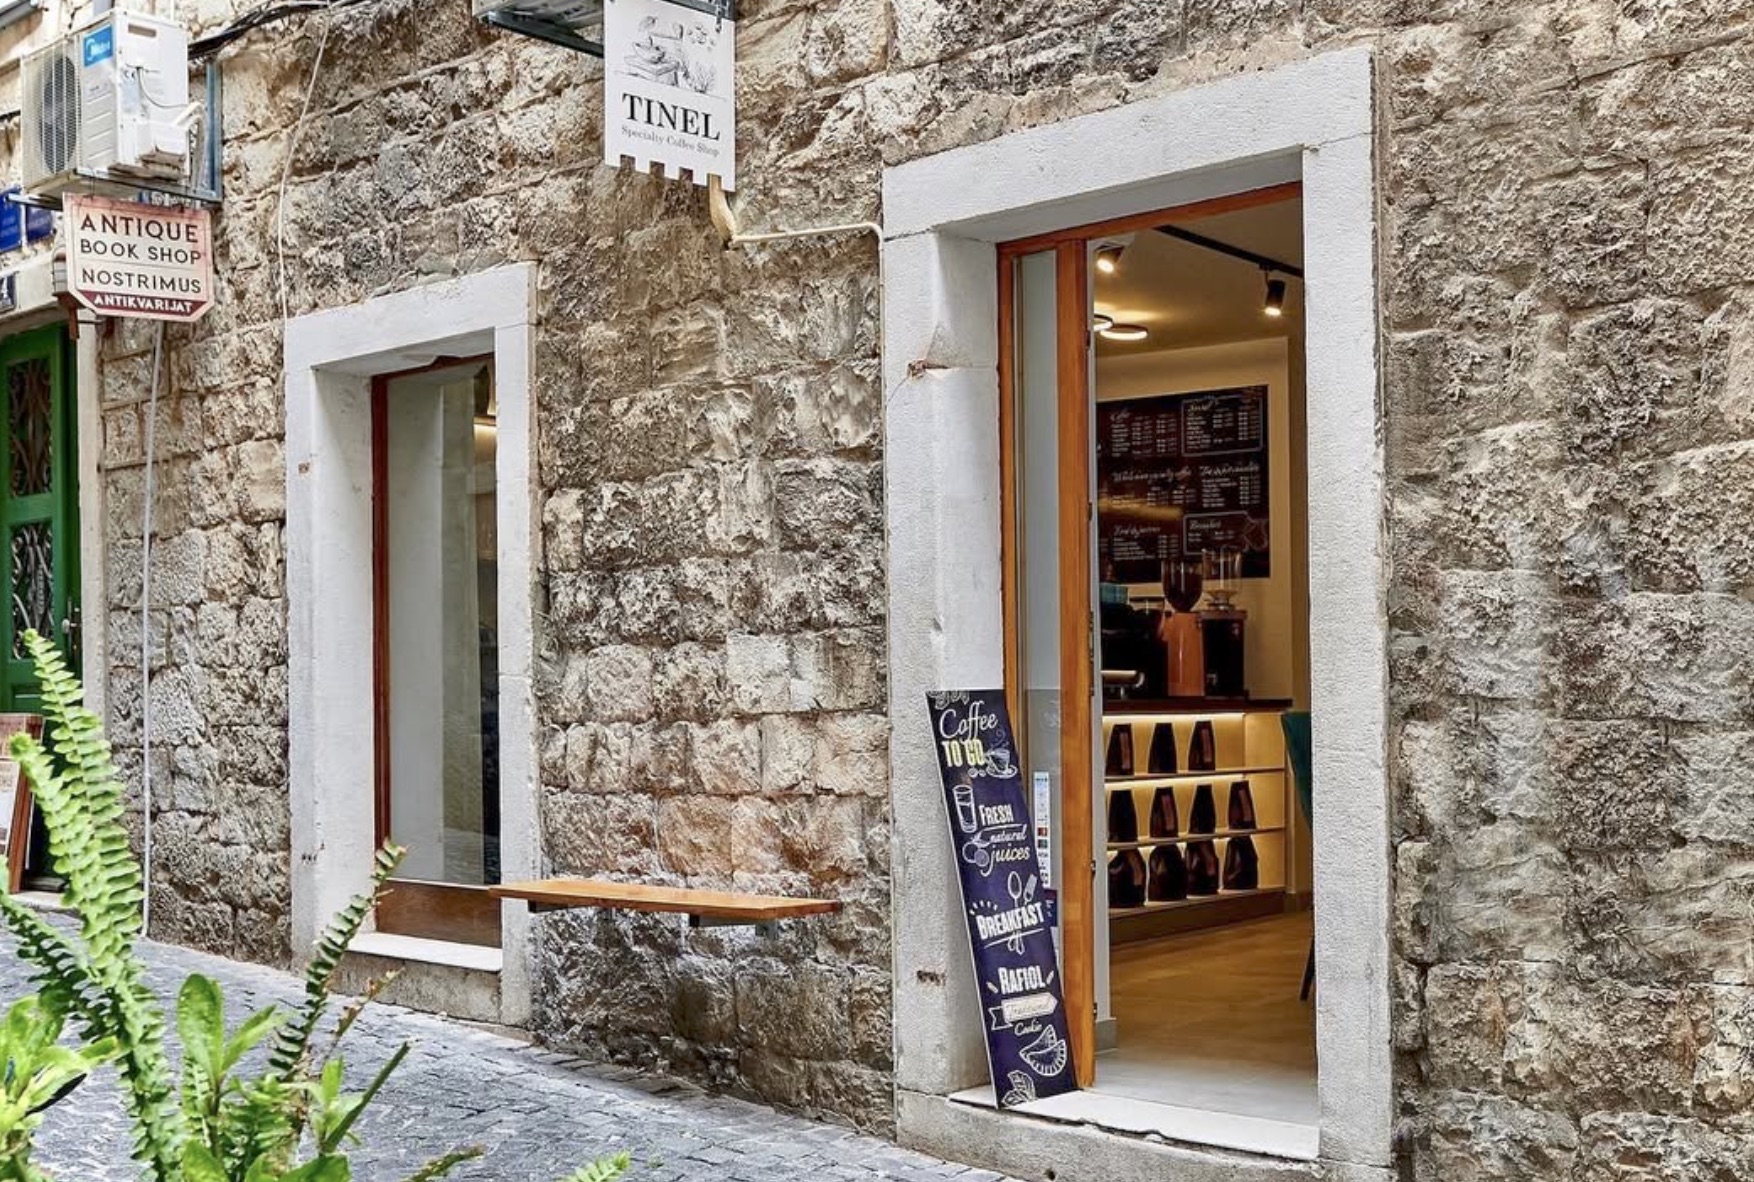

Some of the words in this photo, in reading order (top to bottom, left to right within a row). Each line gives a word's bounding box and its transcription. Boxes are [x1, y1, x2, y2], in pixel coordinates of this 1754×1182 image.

[622, 93, 720, 141] TINEL
[621, 125, 664, 145] Specialty
[666, 134, 695, 151] Coffee
[696, 142, 720, 157] Shop
[81, 213, 199, 243] ANTIQUE
[80, 238, 139, 259] BOOK
[148, 243, 202, 265] SHOP
[82, 268, 202, 294] NOSTRIMUS
[93, 293, 193, 314] ANTIKVARIJAT
[939, 700, 998, 743] Coffee
[942, 739, 963, 767] TO
[962, 738, 985, 766] GO
[978, 804, 1014, 826] FRESH
[990, 823, 1028, 843] natural
[980, 843, 1031, 877] juices
[976, 901, 1045, 939] BREAKFAST
[998, 965, 1046, 995] RAFIOL
